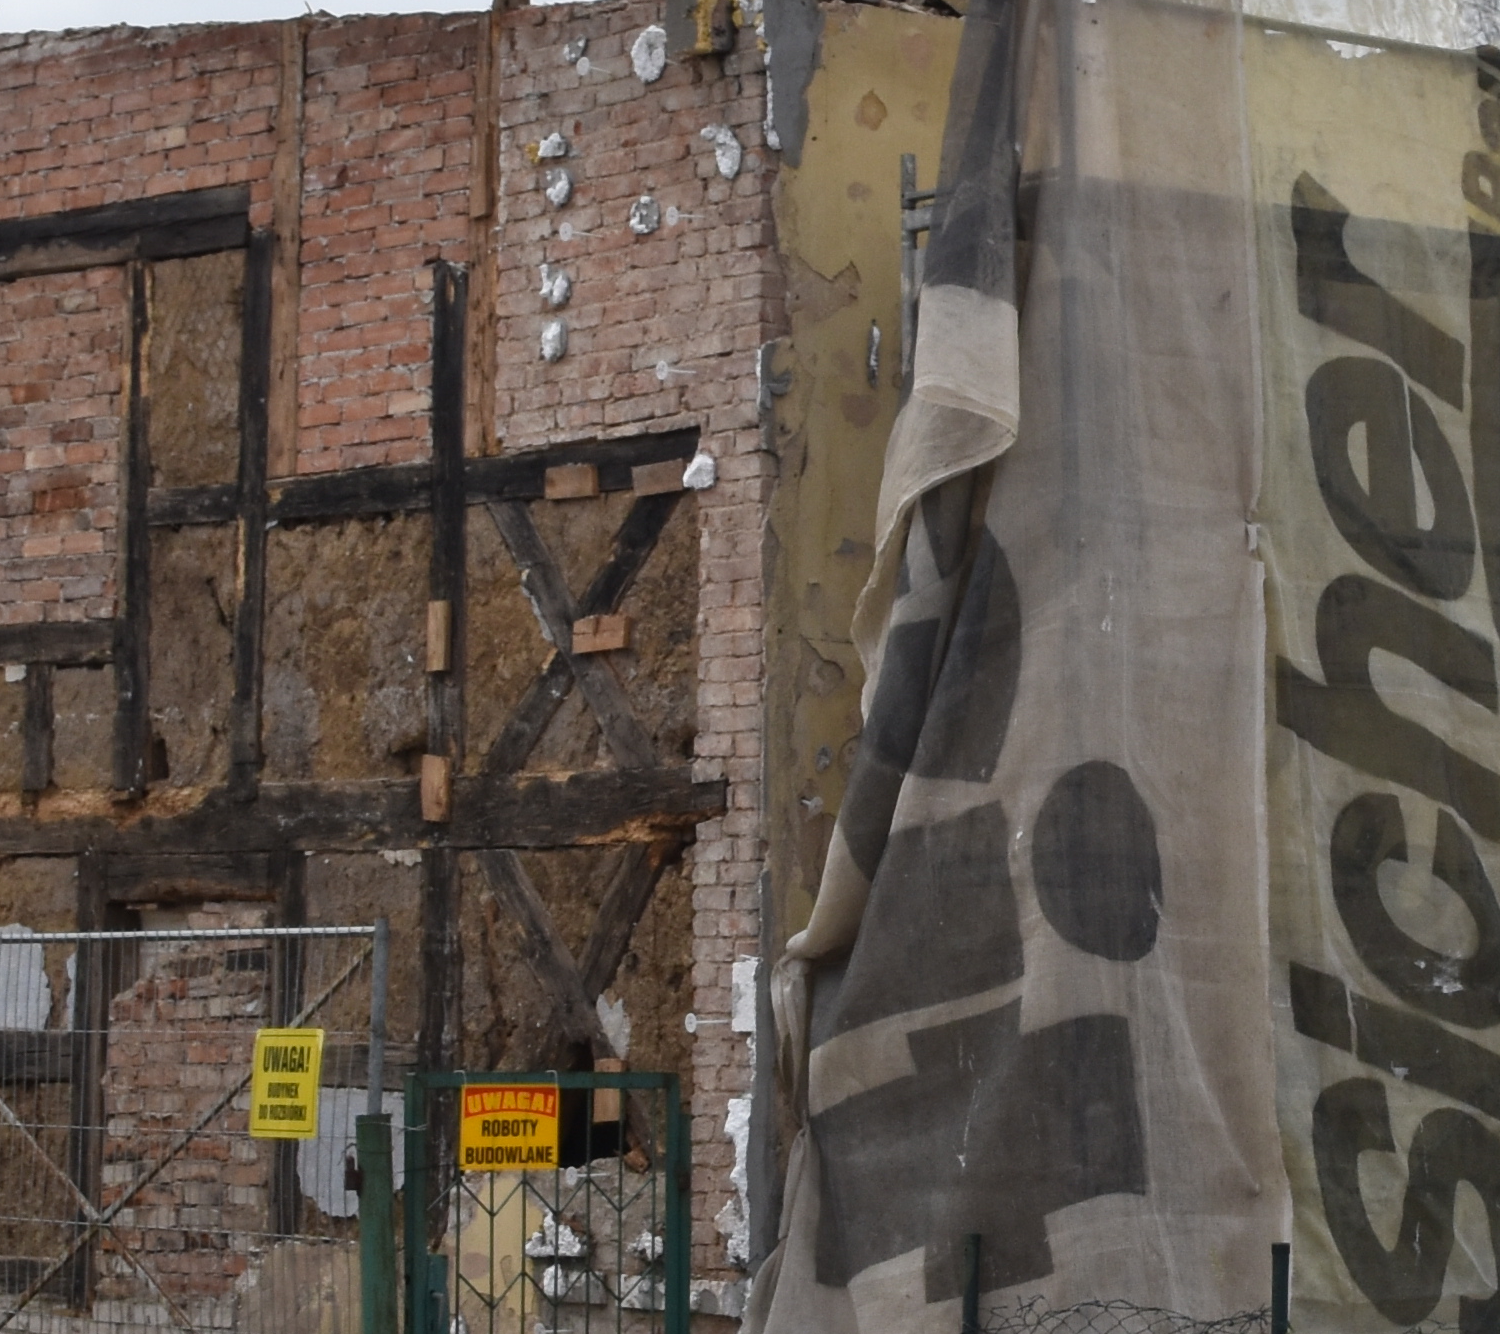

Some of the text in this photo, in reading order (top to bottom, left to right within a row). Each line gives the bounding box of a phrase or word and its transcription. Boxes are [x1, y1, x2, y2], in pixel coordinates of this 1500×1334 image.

[263, 1045, 311, 1073] UWAGA!
[466, 1090, 555, 1114] UWAGA!
[481, 1119, 539, 1137] ROBOTY
[465, 1146, 554, 1165] BUDOWLANE
